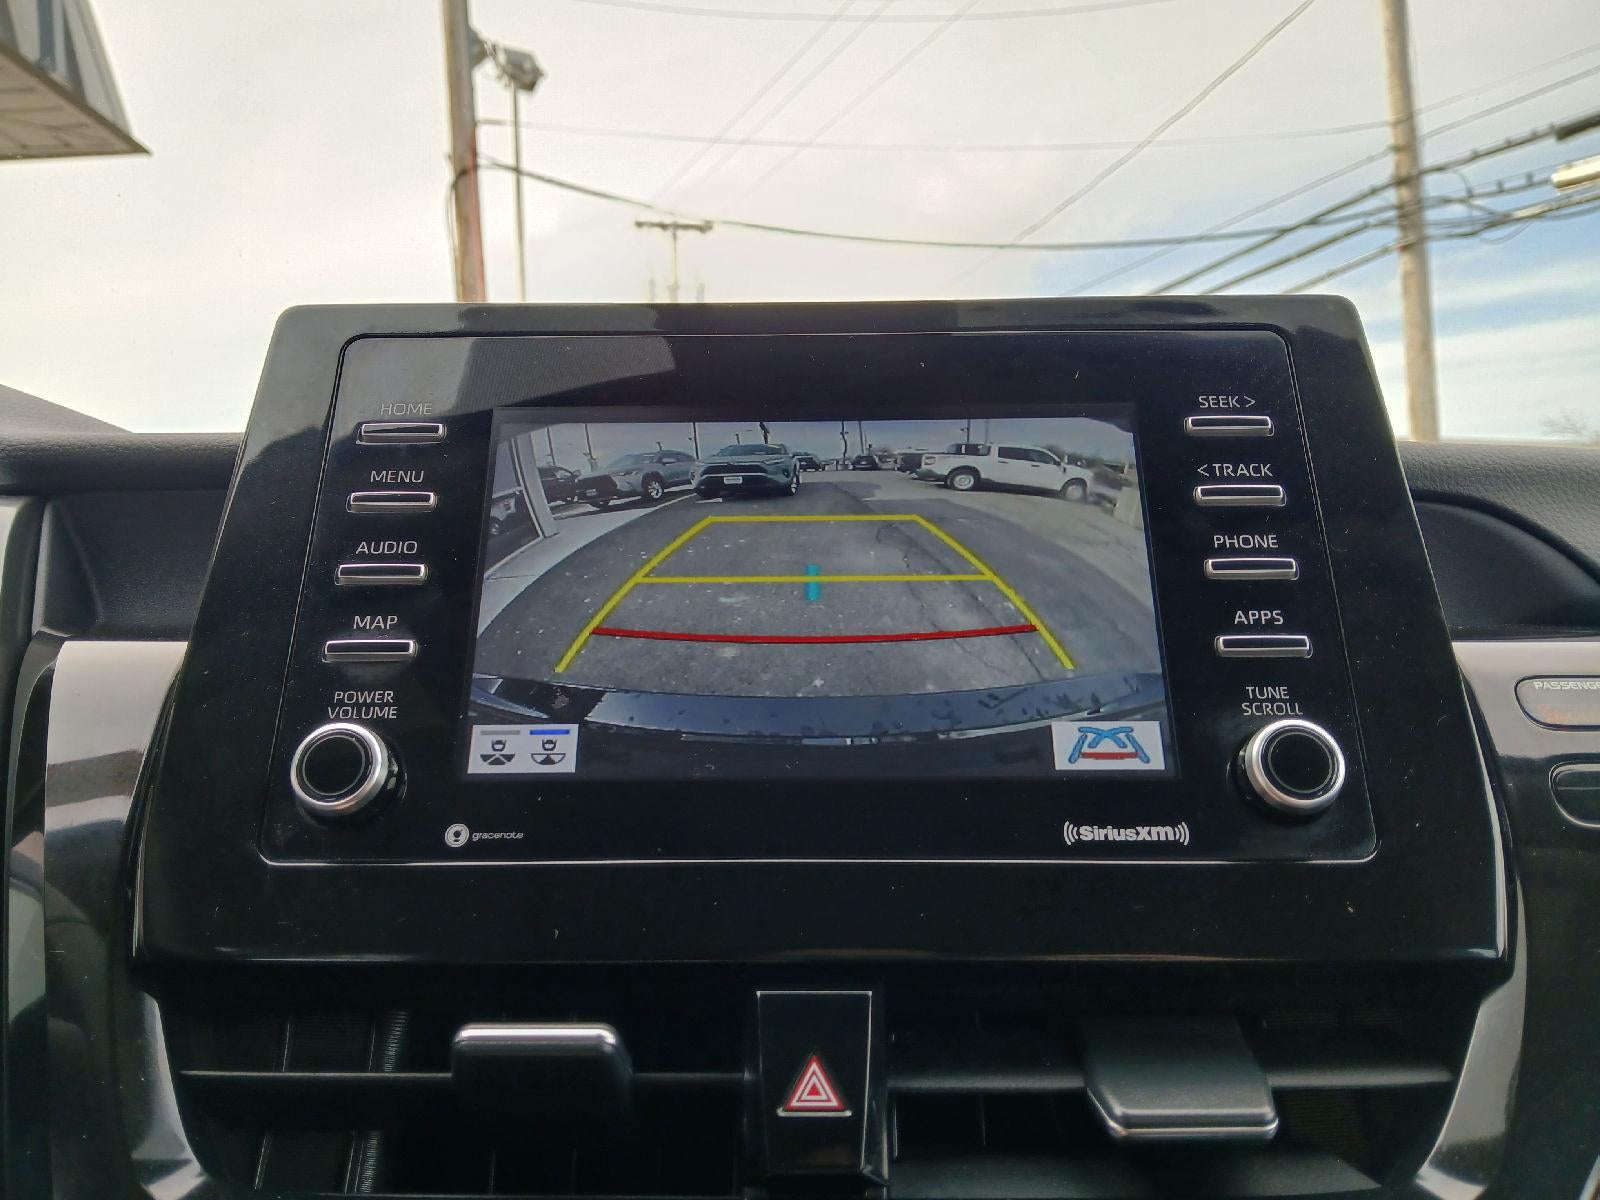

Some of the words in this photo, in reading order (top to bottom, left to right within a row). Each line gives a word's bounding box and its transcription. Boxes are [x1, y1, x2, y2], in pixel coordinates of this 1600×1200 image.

[1198, 395, 1240, 408] SEEK
[380, 402, 433, 416] HOME
[370, 470, 425, 483] MENU
[1212, 463, 1274, 477] TRACK
[355, 540, 418, 554] AUDIO
[1213, 534, 1279, 549] PHONE
[352, 615, 398, 630] MAP
[1233, 610, 1284, 625] APPS
[334, 690, 394, 704] POWER
[1246, 686, 1290, 699] TUNE
[327, 706, 398, 720] VOLUME
[1240, 701, 1303, 716] SCROLL
